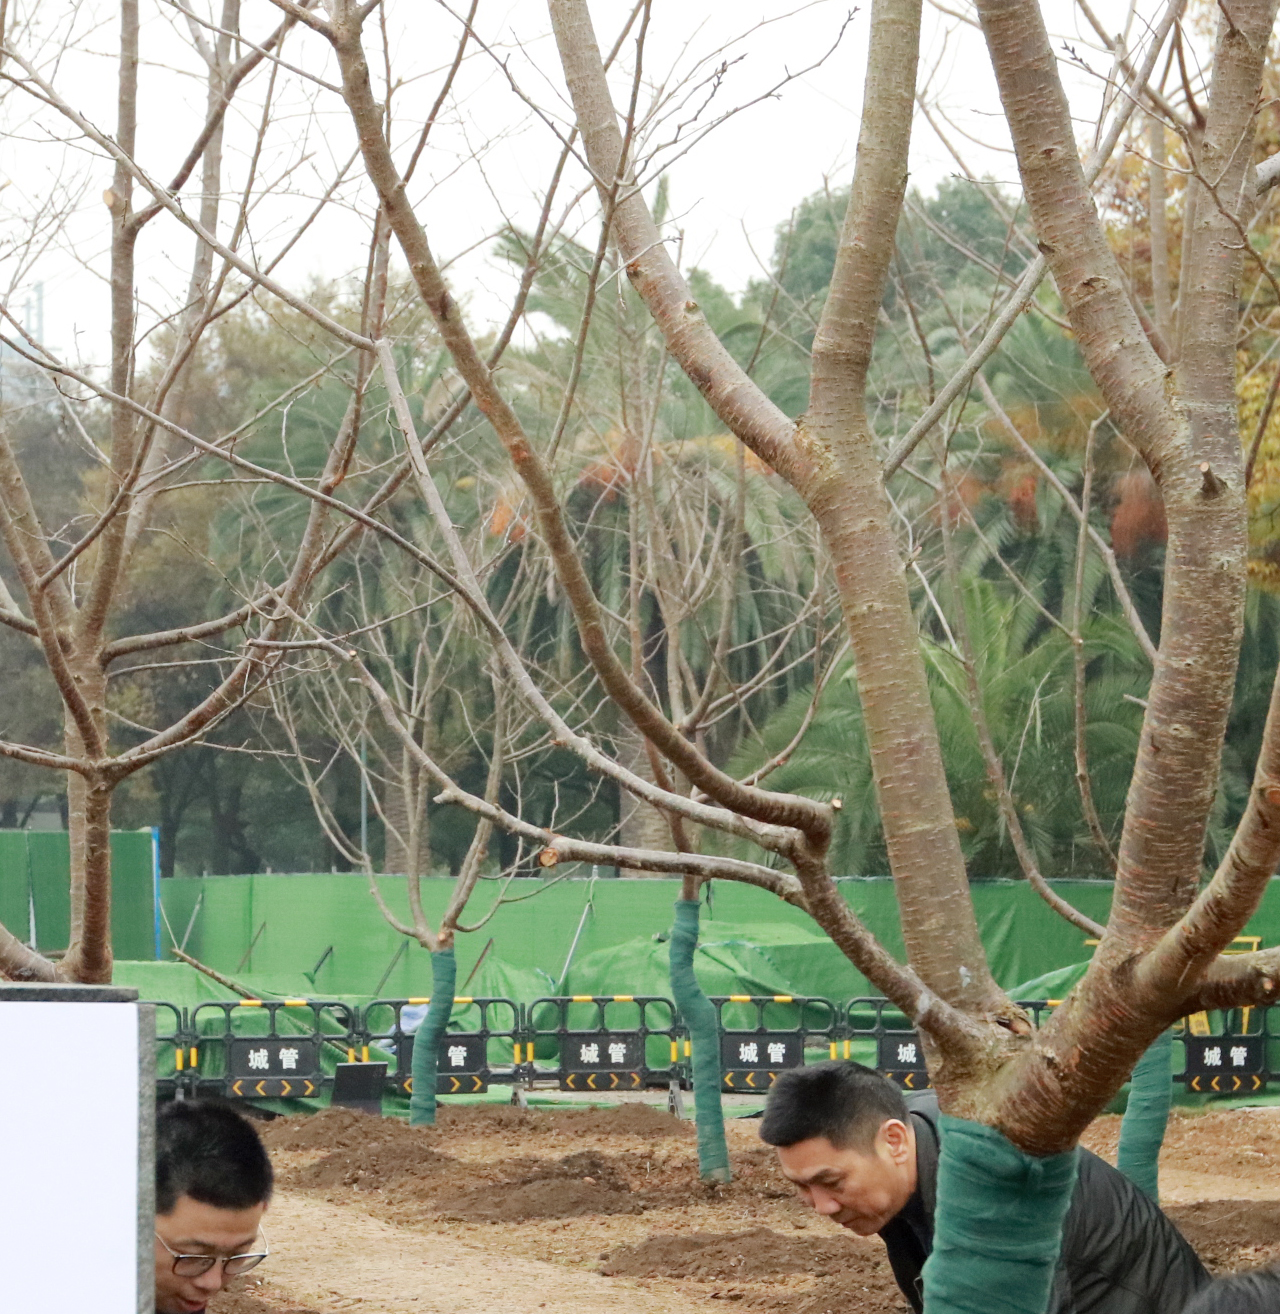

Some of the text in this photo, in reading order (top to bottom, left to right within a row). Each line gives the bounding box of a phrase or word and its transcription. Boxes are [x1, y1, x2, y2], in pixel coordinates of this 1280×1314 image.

[248, 1048, 300, 1070] 城管
[436, 1045, 468, 1067] 管
[580, 1043, 627, 1064] 城管
[739, 1042, 786, 1063] 城管
[1203, 1046, 1248, 1067] 城管
